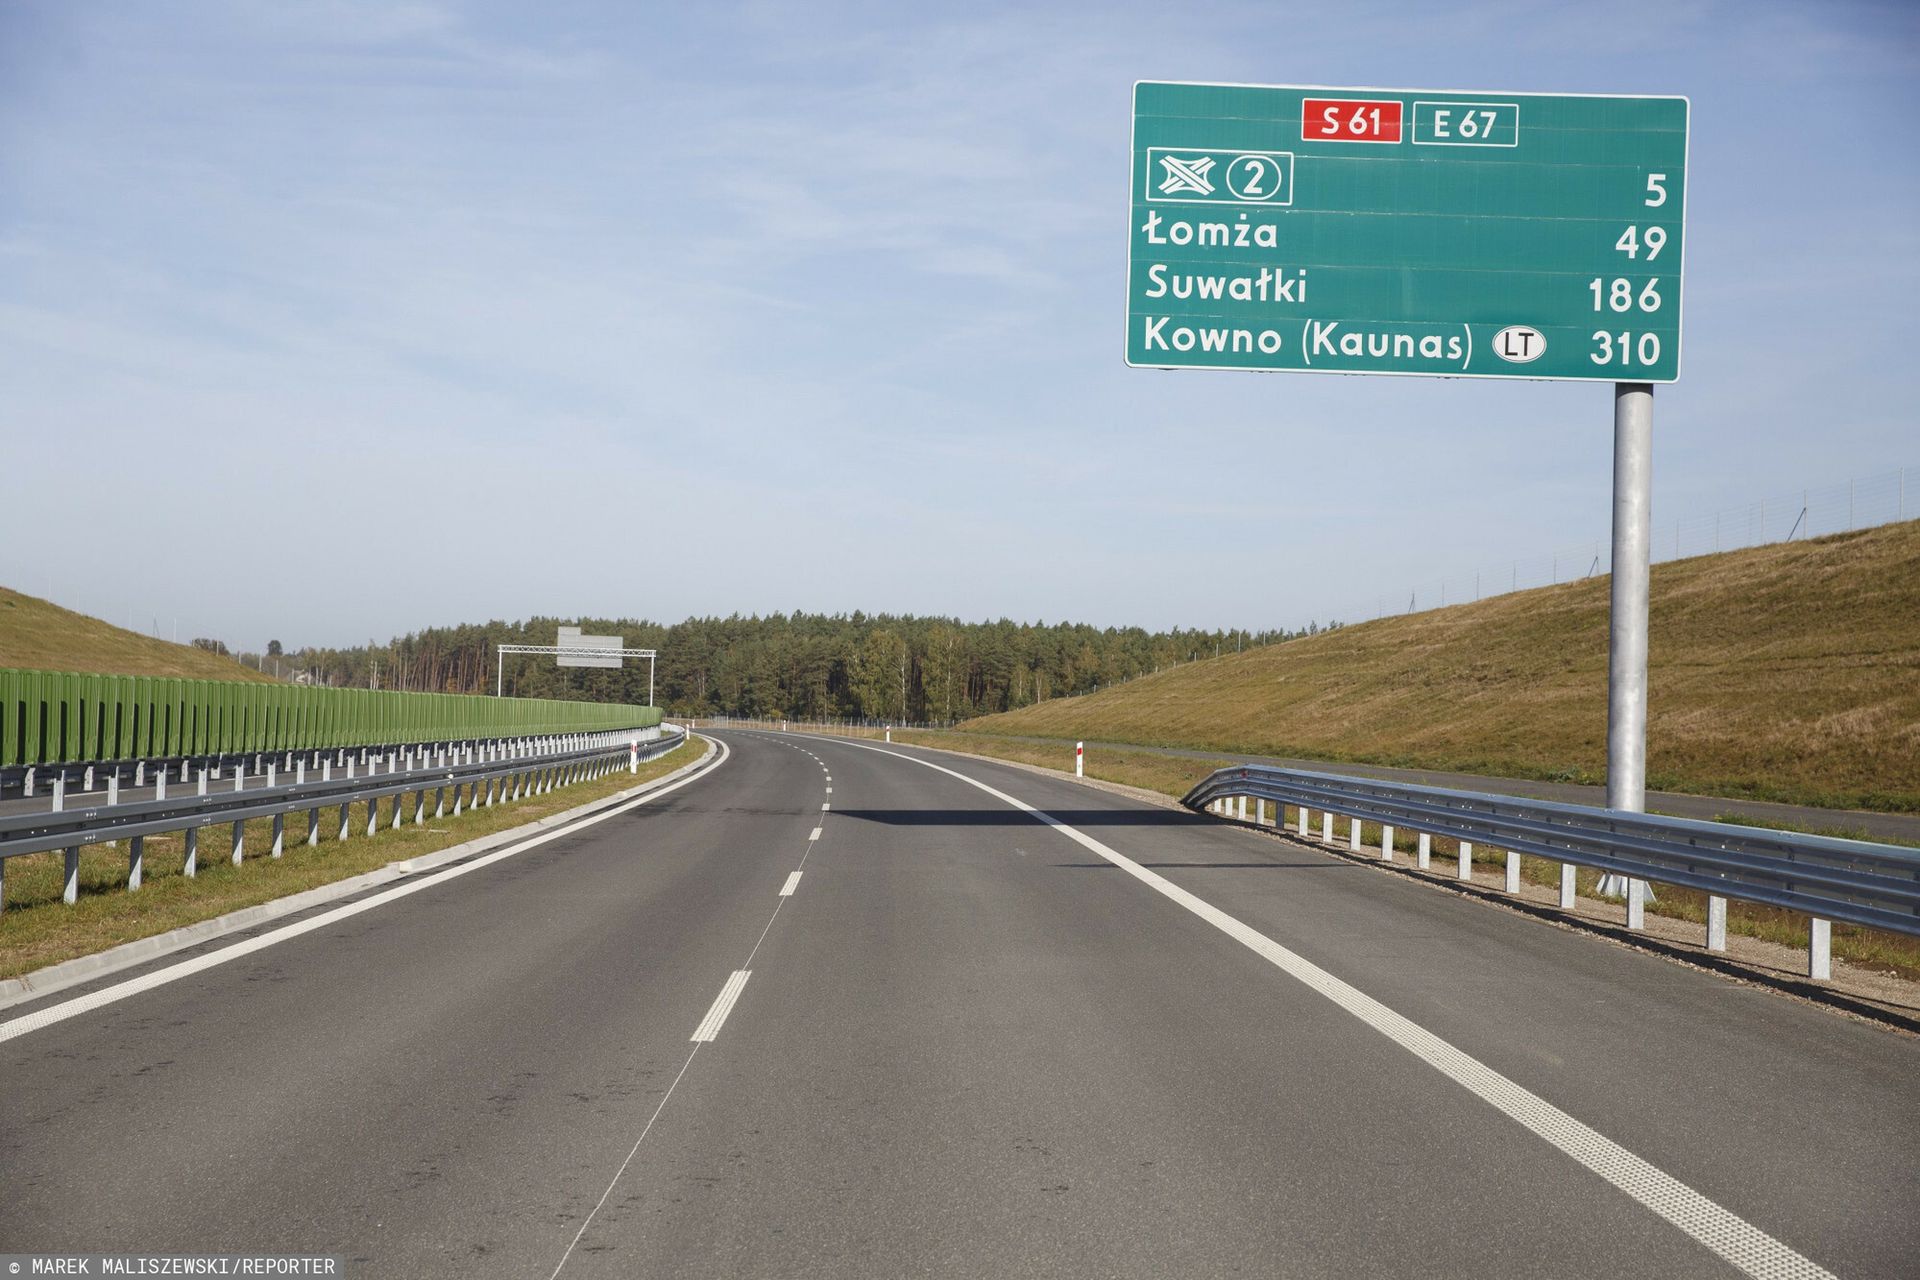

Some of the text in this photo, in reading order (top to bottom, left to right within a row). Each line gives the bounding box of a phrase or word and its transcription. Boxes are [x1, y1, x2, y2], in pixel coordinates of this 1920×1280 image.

[1322, 107, 1380, 136] S 61
[1434, 110, 1497, 139] E 67
[1243, 160, 1667, 208] 2 5
[1141, 210, 1667, 261] Łomża 49
[1145, 263, 1662, 313] Suwałki 186
[1144, 316, 1661, 370] Kowno (Kaunas) LT 310
